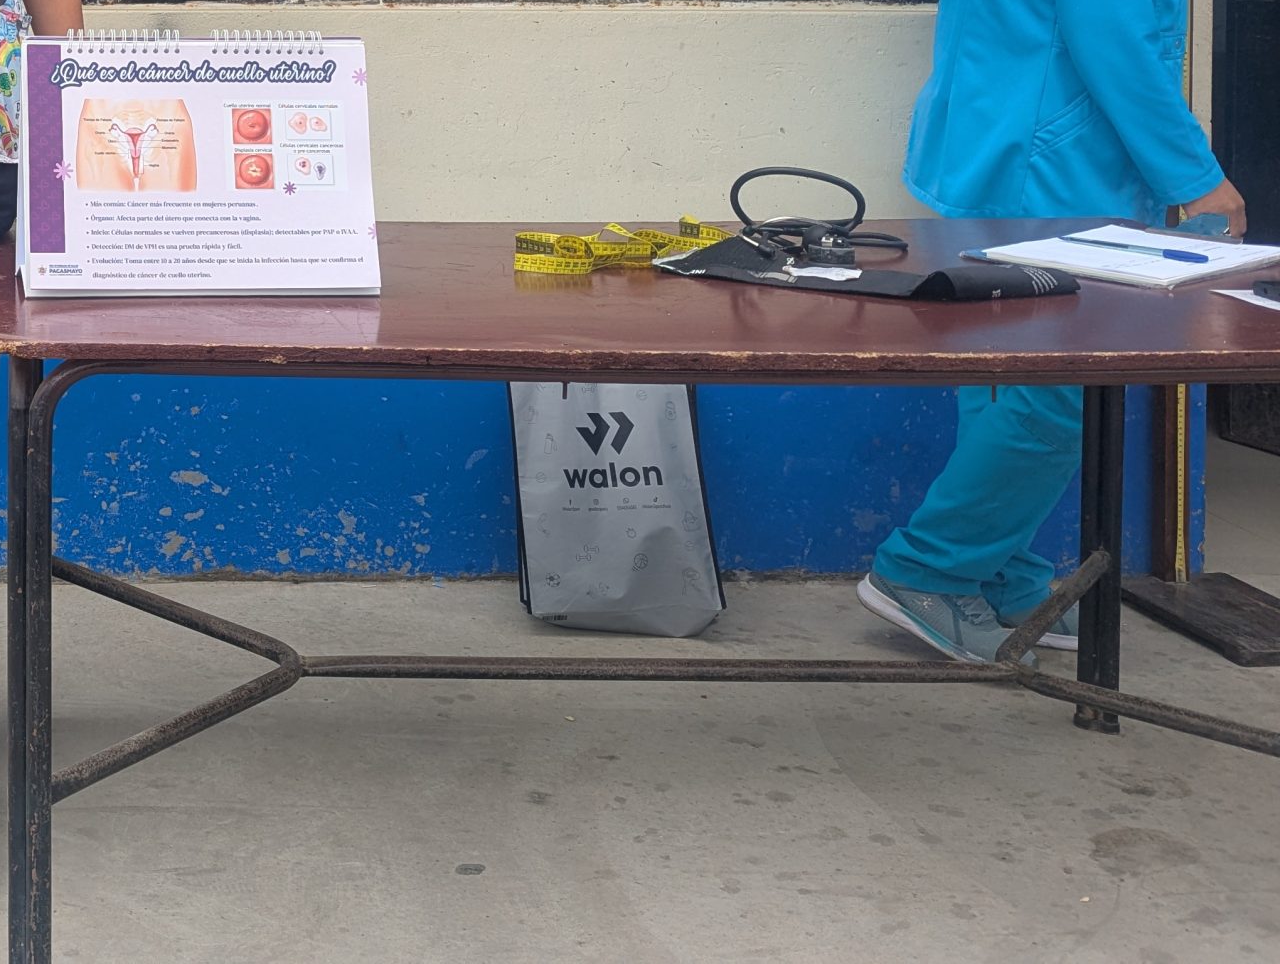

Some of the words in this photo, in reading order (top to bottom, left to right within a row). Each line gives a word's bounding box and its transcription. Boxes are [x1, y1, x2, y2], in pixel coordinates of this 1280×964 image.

[51, 62, 97, 87] ¿Qué
[100, 68, 116, 82] es
[120, 62, 136, 83] el
[138, 61, 190, 84] cáncer
[195, 60, 215, 83] de
[218, 62, 266, 84] cuello
[269, 60, 337, 84] uterino?
[563, 462, 663, 489] walon
